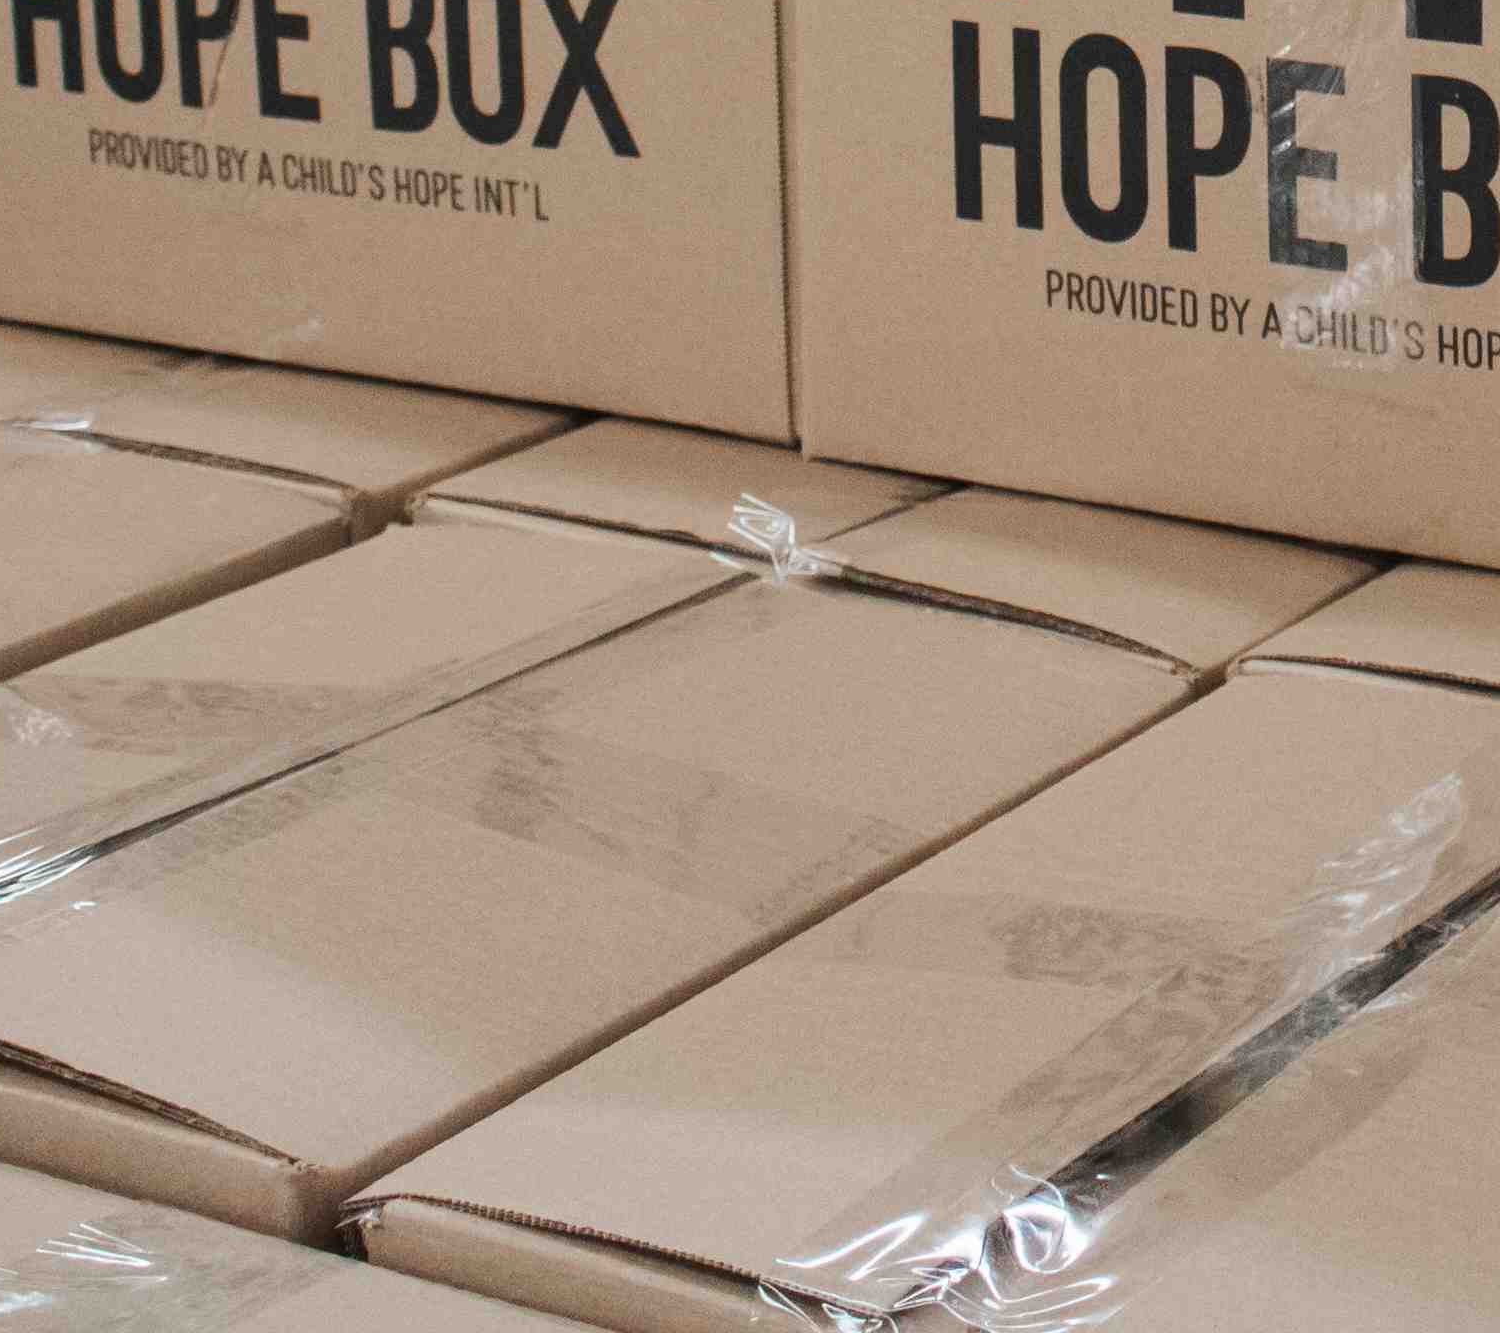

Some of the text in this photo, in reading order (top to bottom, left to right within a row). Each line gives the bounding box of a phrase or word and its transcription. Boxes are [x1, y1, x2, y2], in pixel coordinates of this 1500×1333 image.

[88, 128, 550, 222] PROVIDED BY A CHILD'S HOPE INT'L
[952, 20, 1350, 273] HOPE
[1045, 269, 1199, 329] PROVIDED
[1210, 292, 1251, 336] BY
[1260, 301, 1283, 339] A
[1295, 305, 1426, 362] CHILD'S
